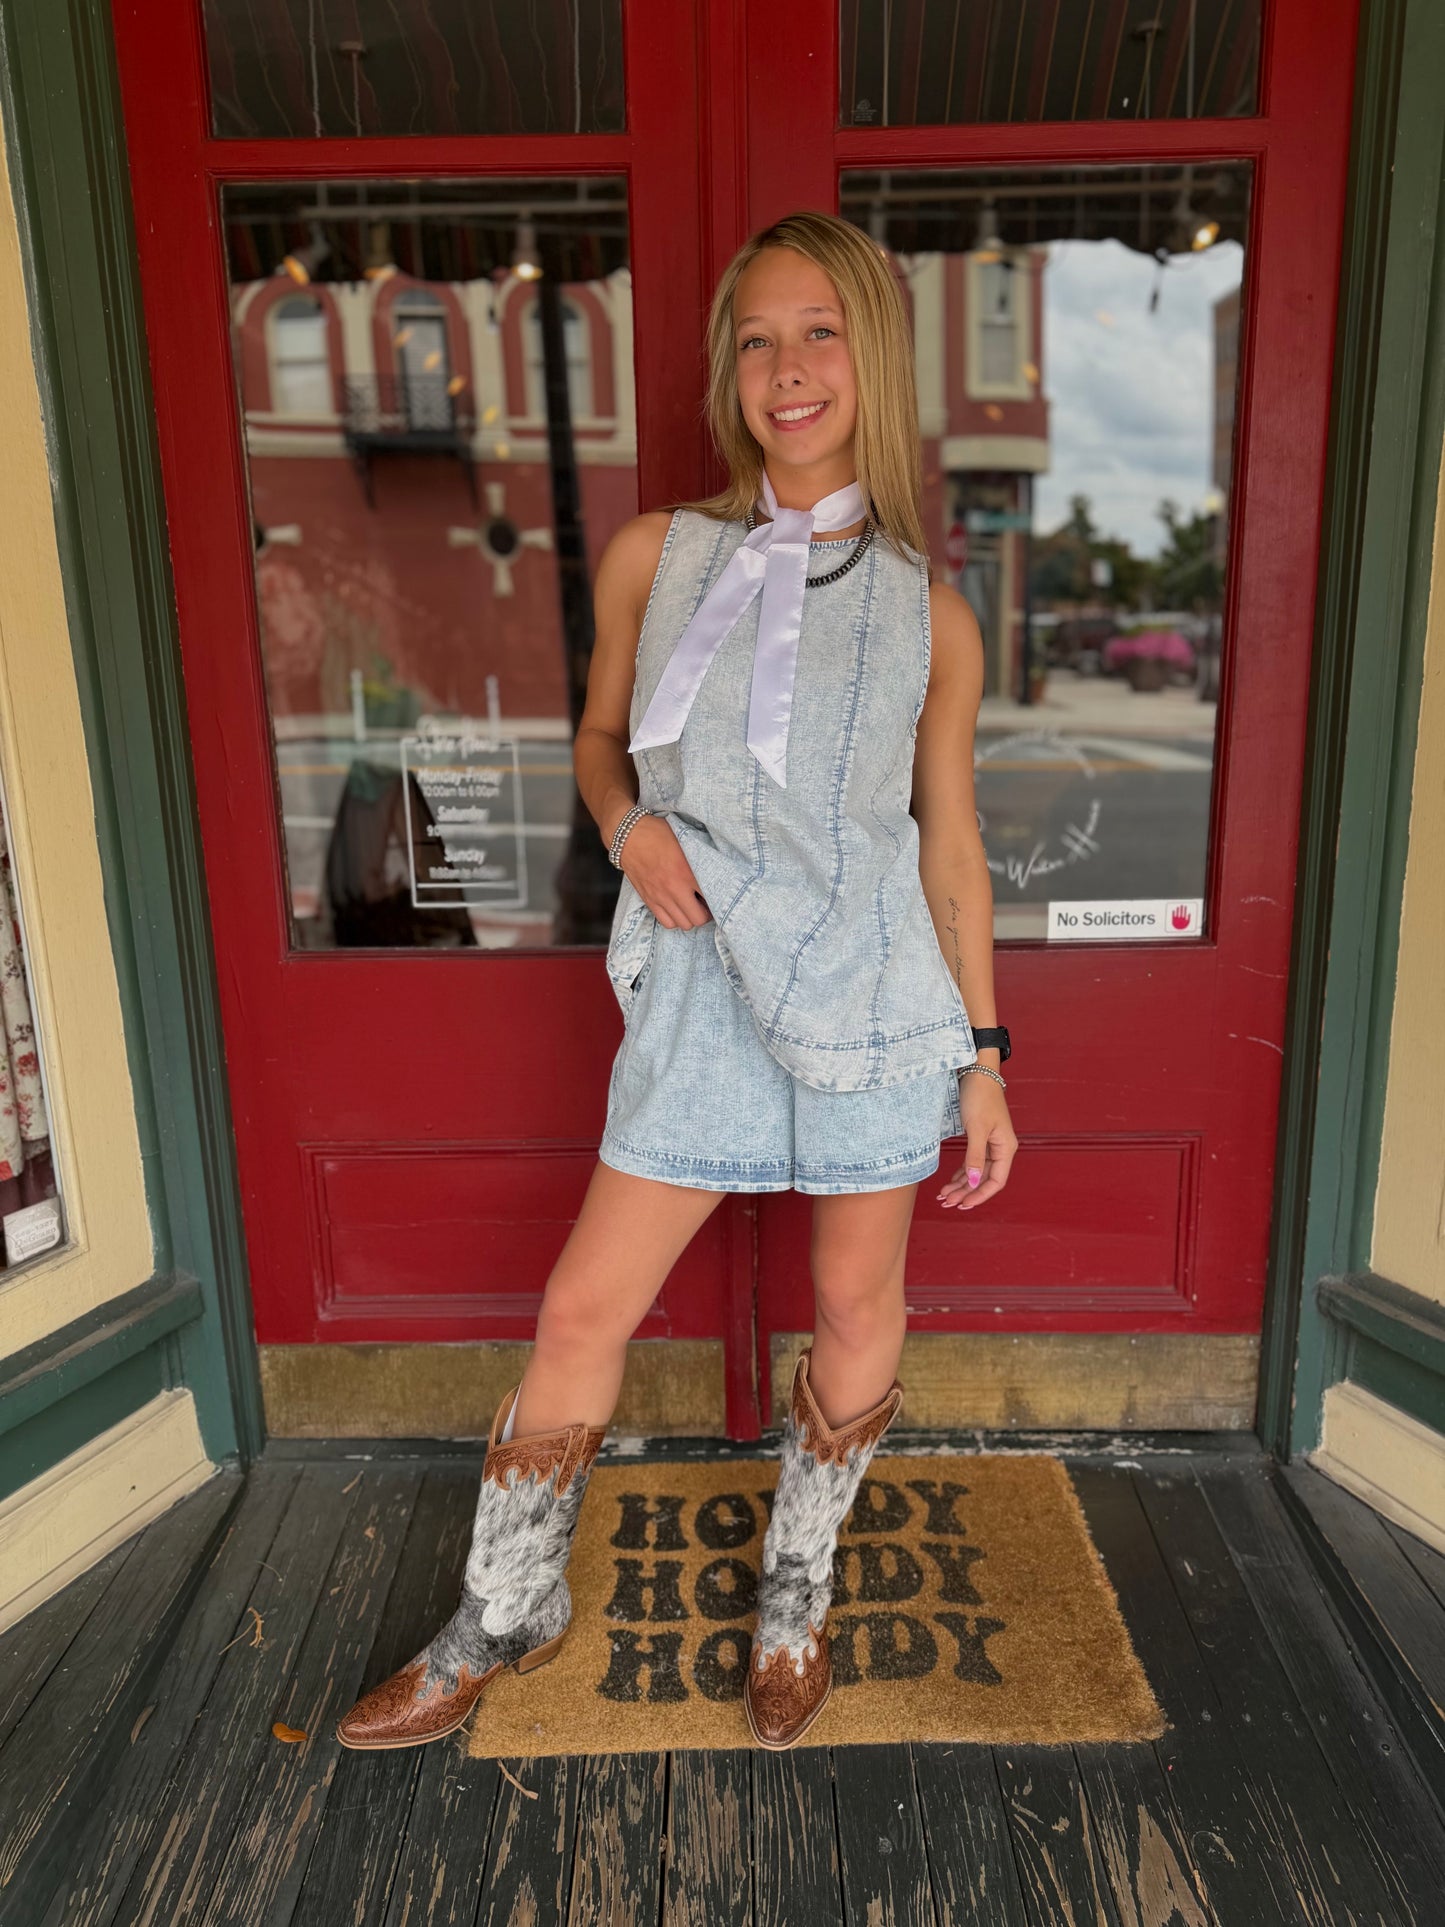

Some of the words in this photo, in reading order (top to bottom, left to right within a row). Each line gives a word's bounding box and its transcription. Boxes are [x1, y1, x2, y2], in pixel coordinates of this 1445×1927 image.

[1057, 912, 1078, 926] No
[1083, 911, 1156, 926] Solicitors
[610, 1479, 970, 1551] HODY
[604, 1542, 987, 1622] HODY
